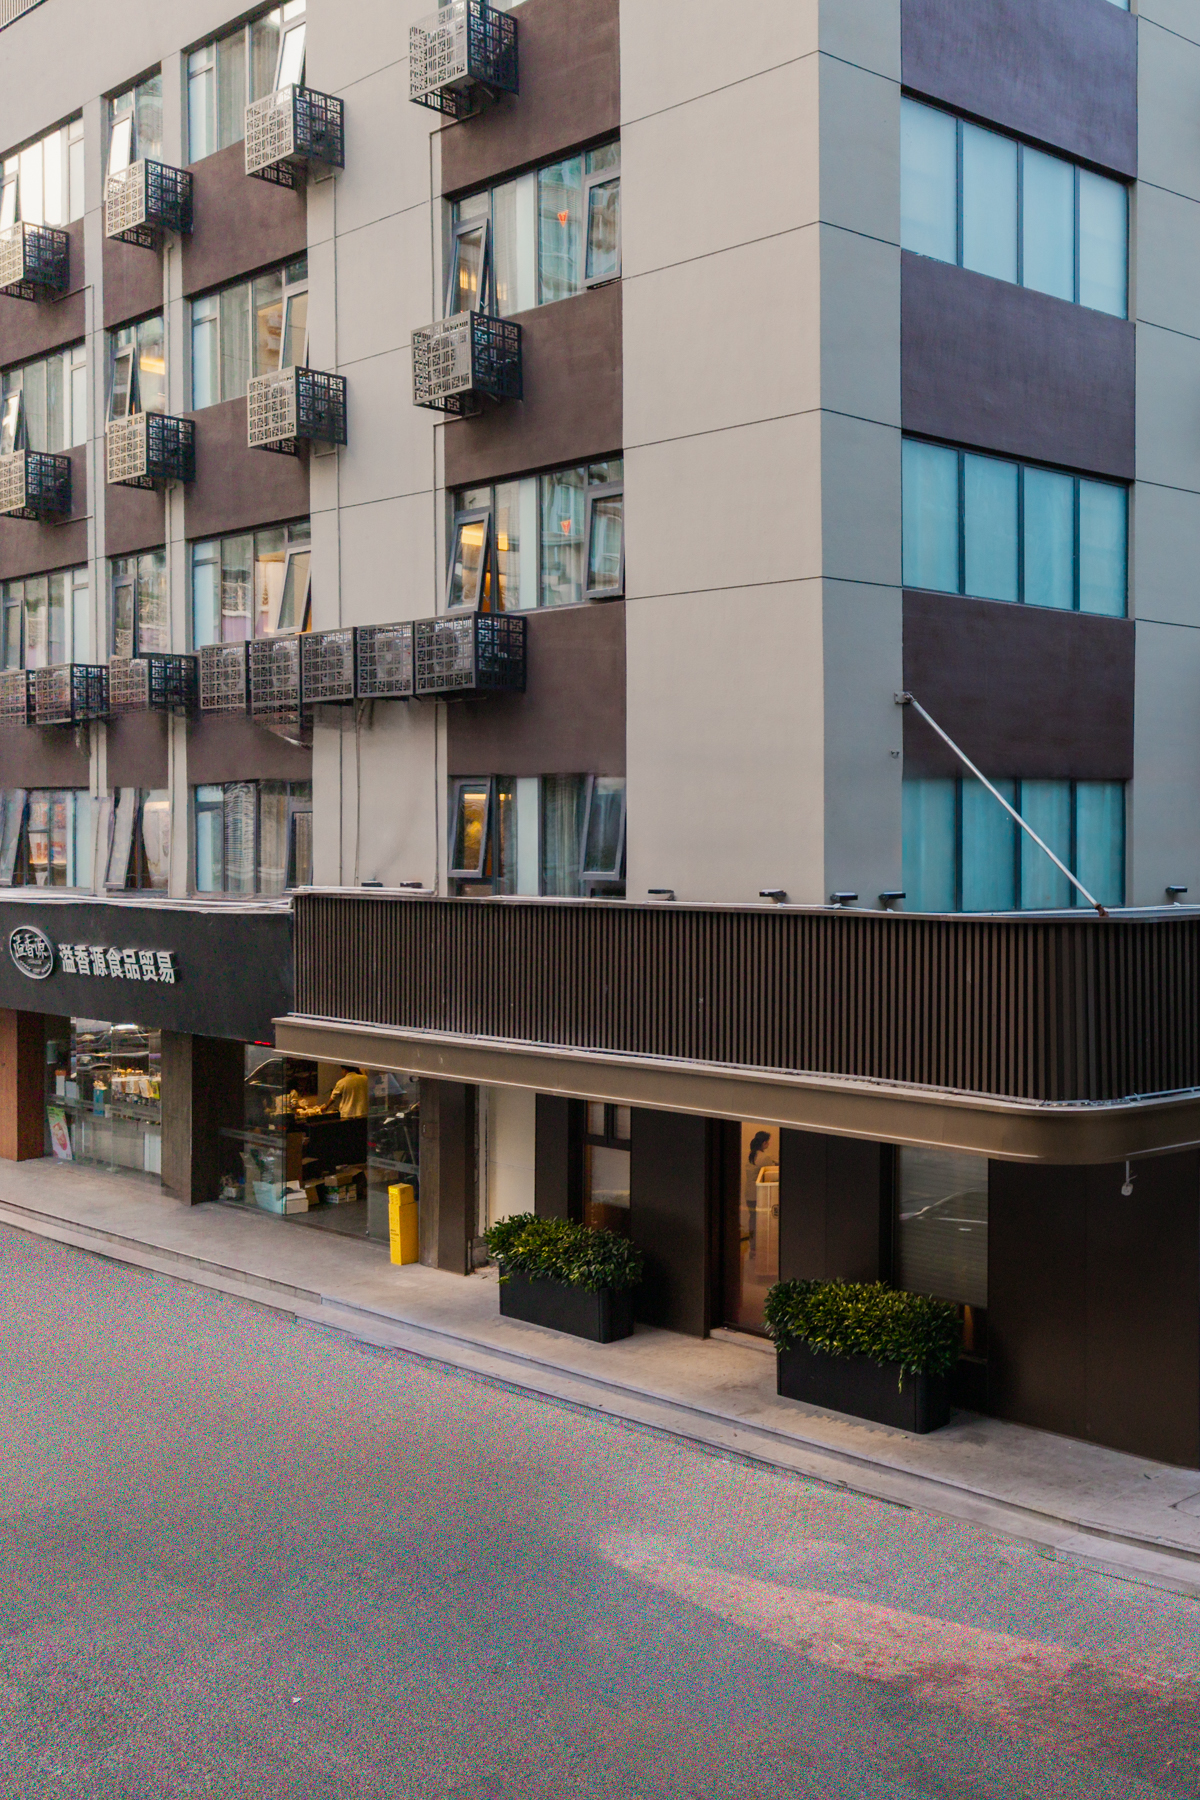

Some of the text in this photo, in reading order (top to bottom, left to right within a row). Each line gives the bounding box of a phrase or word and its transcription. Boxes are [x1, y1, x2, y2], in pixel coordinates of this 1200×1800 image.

[58, 944, 176, 984] 溢香源食品贸易
